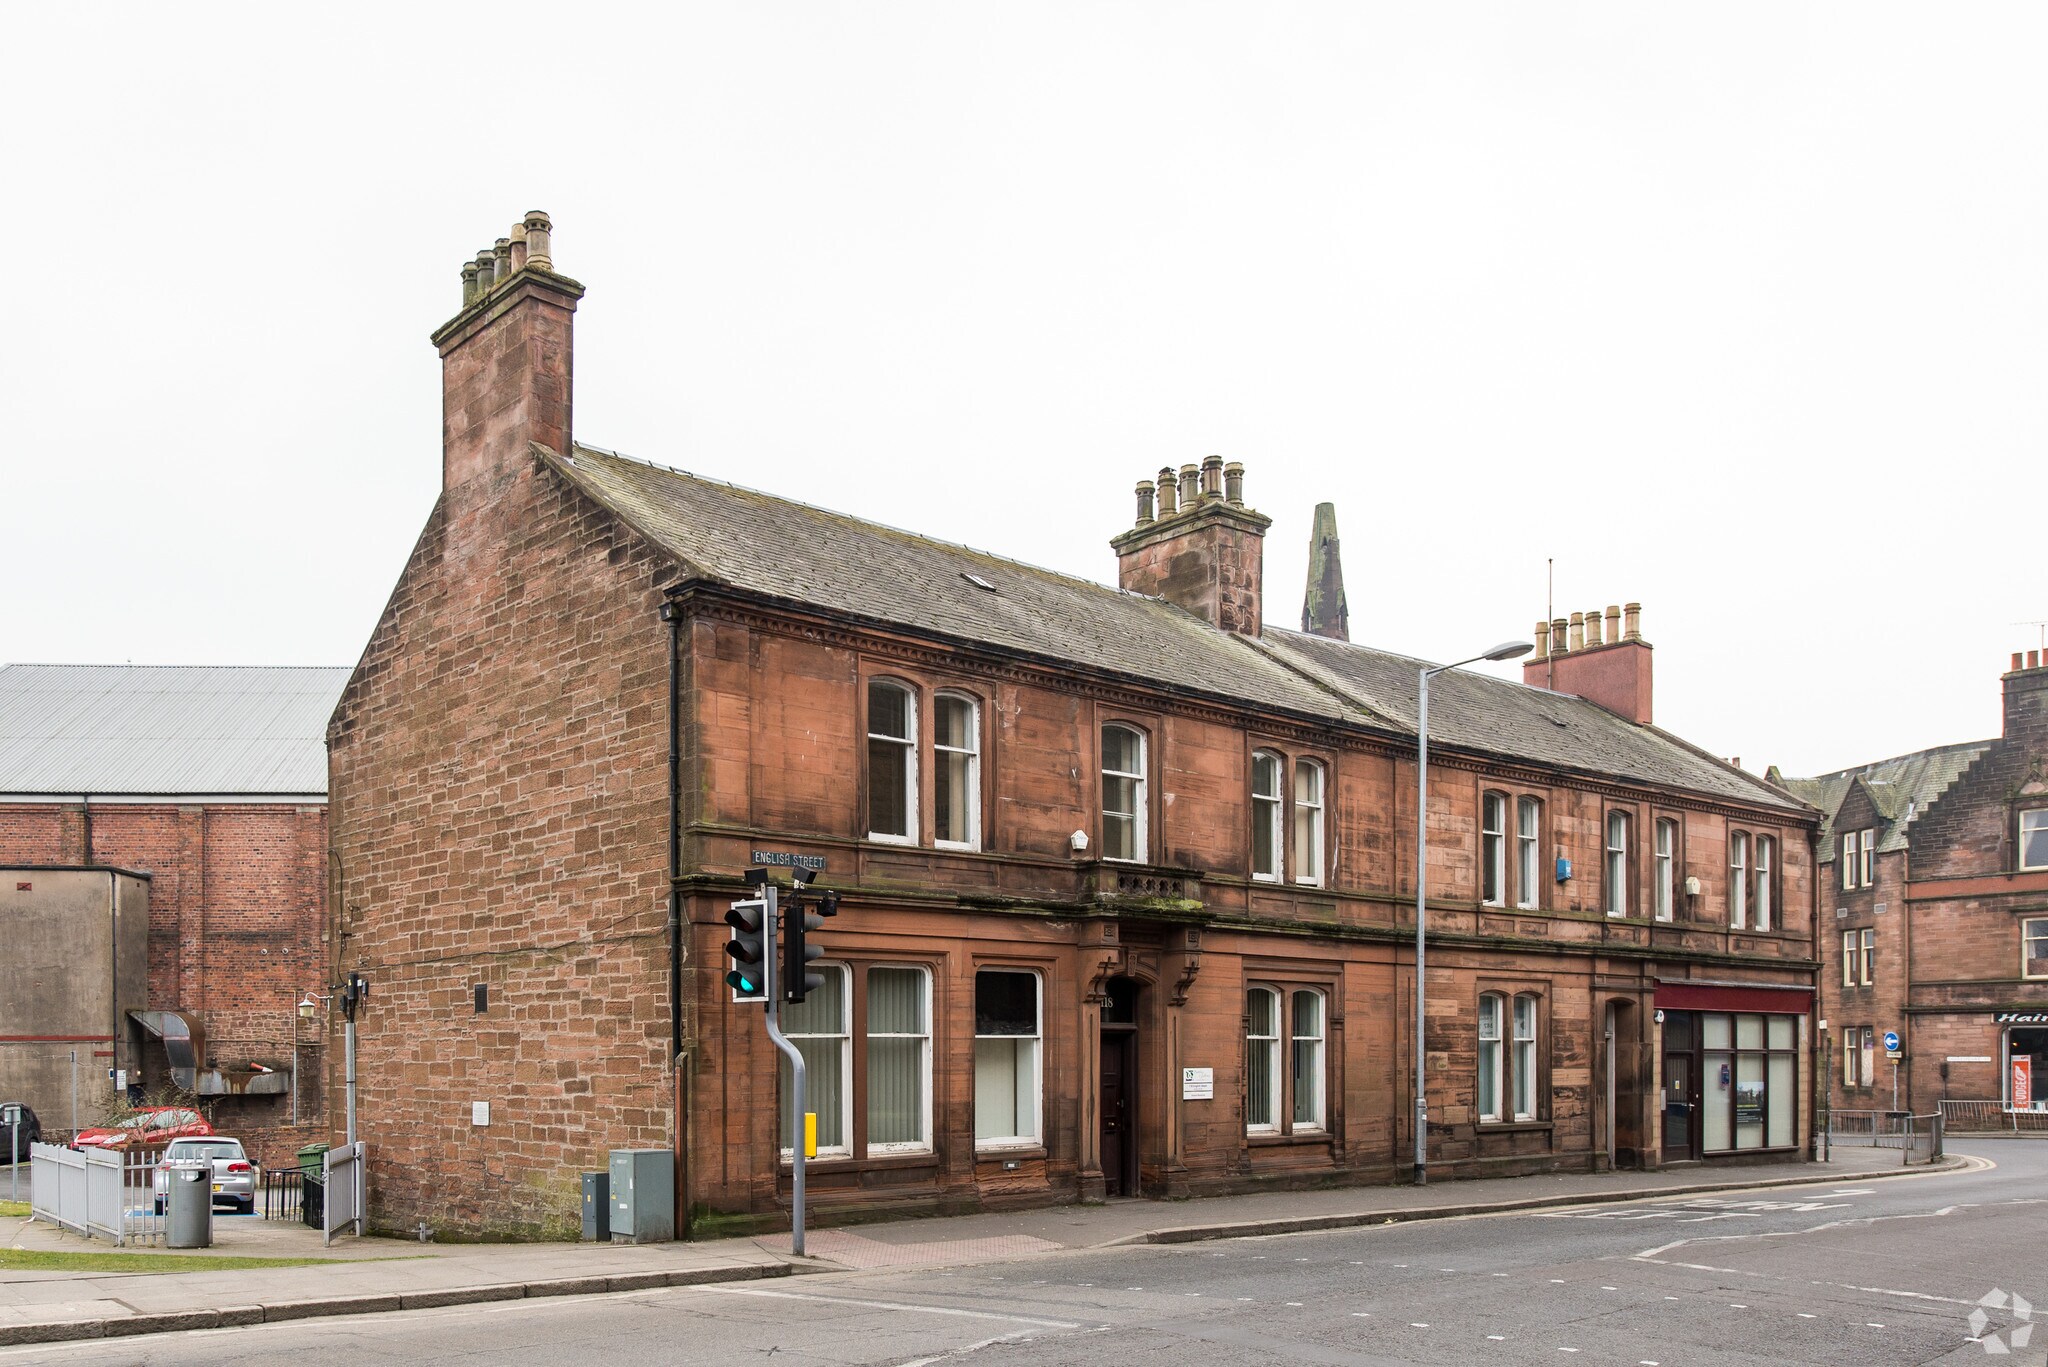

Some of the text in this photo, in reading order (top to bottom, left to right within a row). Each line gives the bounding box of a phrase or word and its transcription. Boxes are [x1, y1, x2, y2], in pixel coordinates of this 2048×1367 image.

[755, 851, 823, 868] ENGLISH STREET
[1531, 1208, 1761, 1222] LEFT
